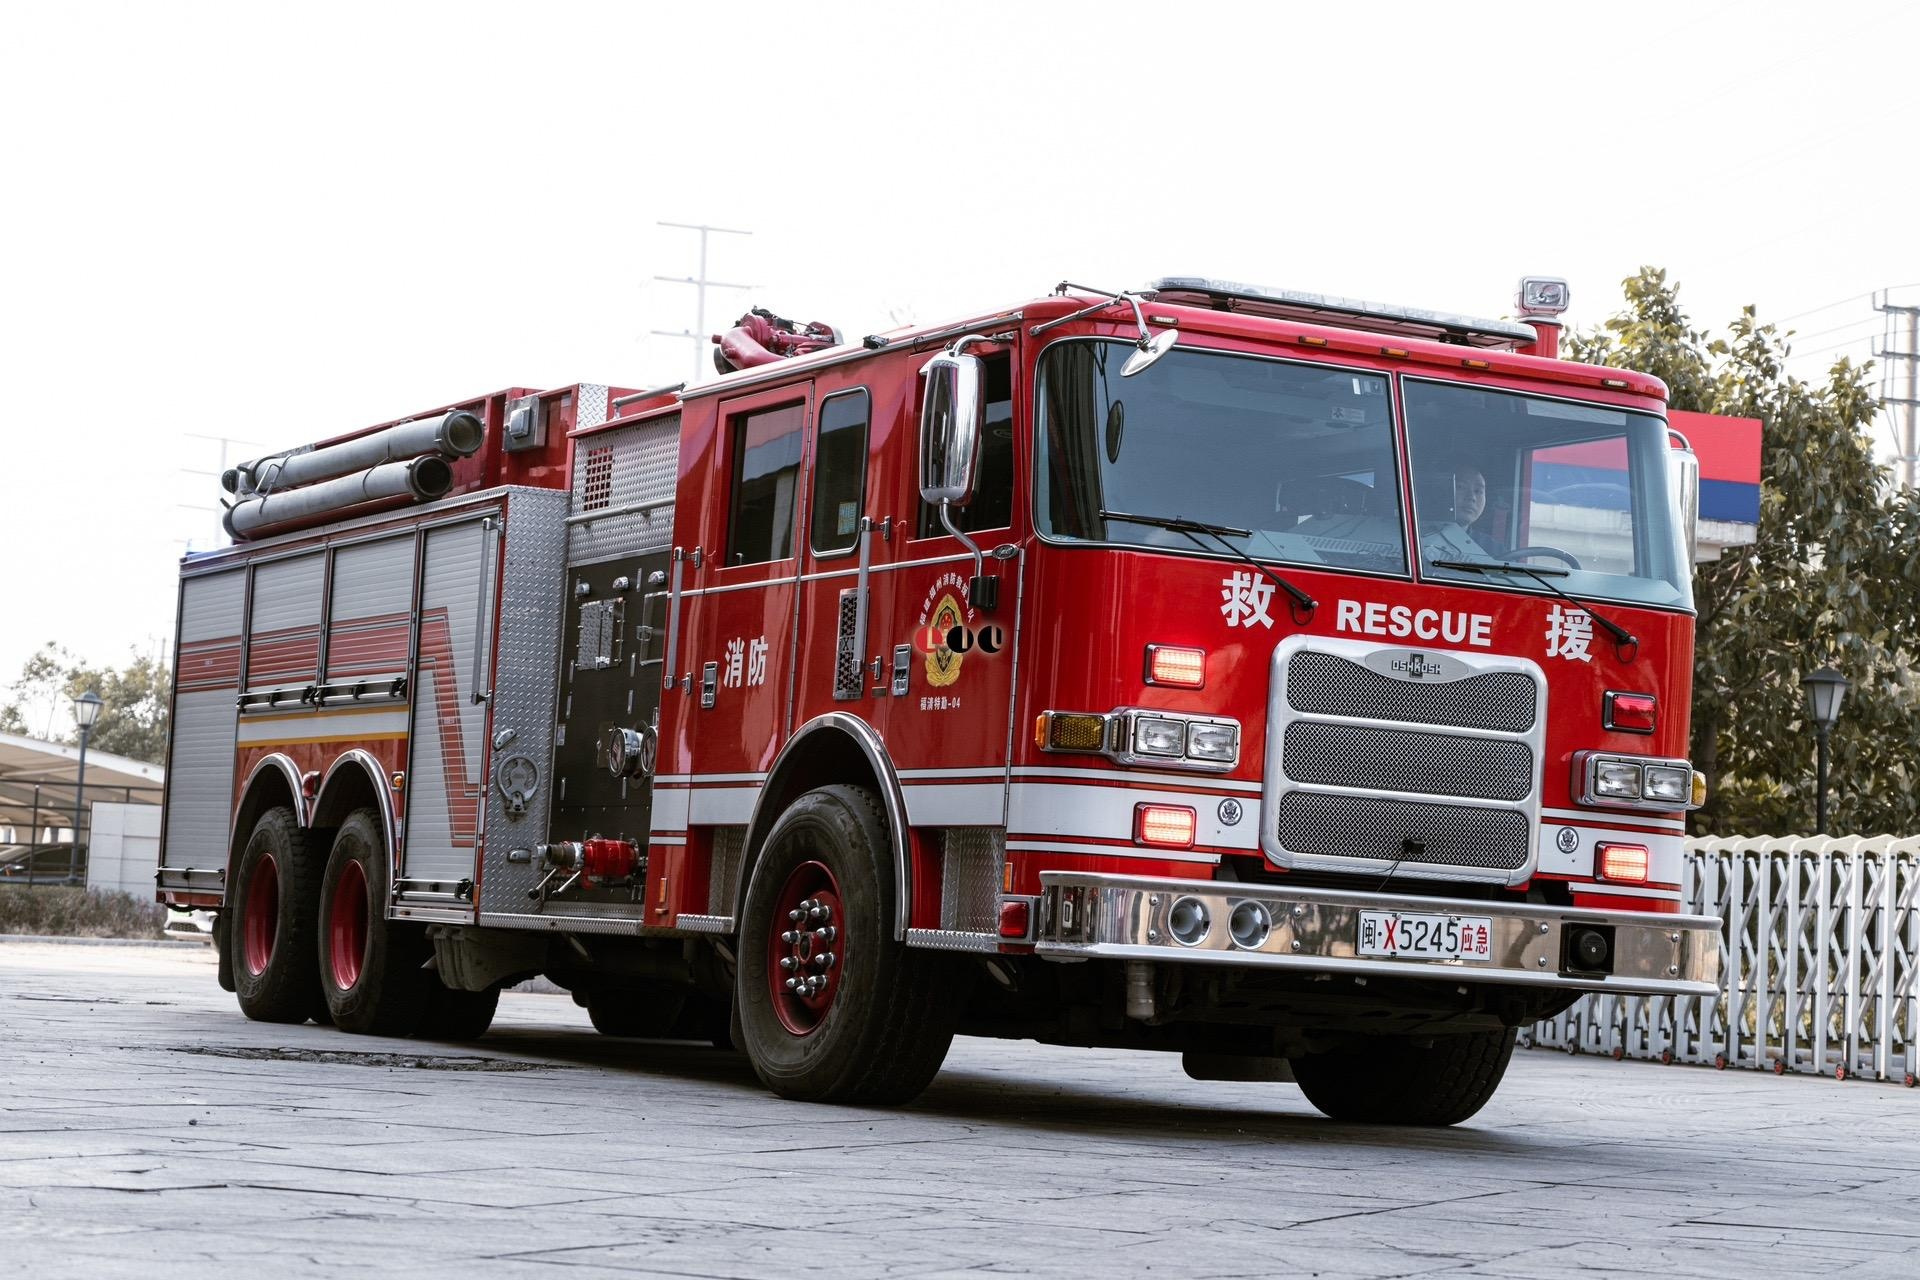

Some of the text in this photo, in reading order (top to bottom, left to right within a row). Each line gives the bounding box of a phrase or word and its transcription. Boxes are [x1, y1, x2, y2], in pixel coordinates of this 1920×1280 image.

[1220, 571, 1276, 629] 救
[1336, 599, 1492, 647] RESCUE
[1545, 604, 1593, 663] 援
[723, 635, 768, 688] 消防
[1391, 658, 1442, 676] OSHKOSH
